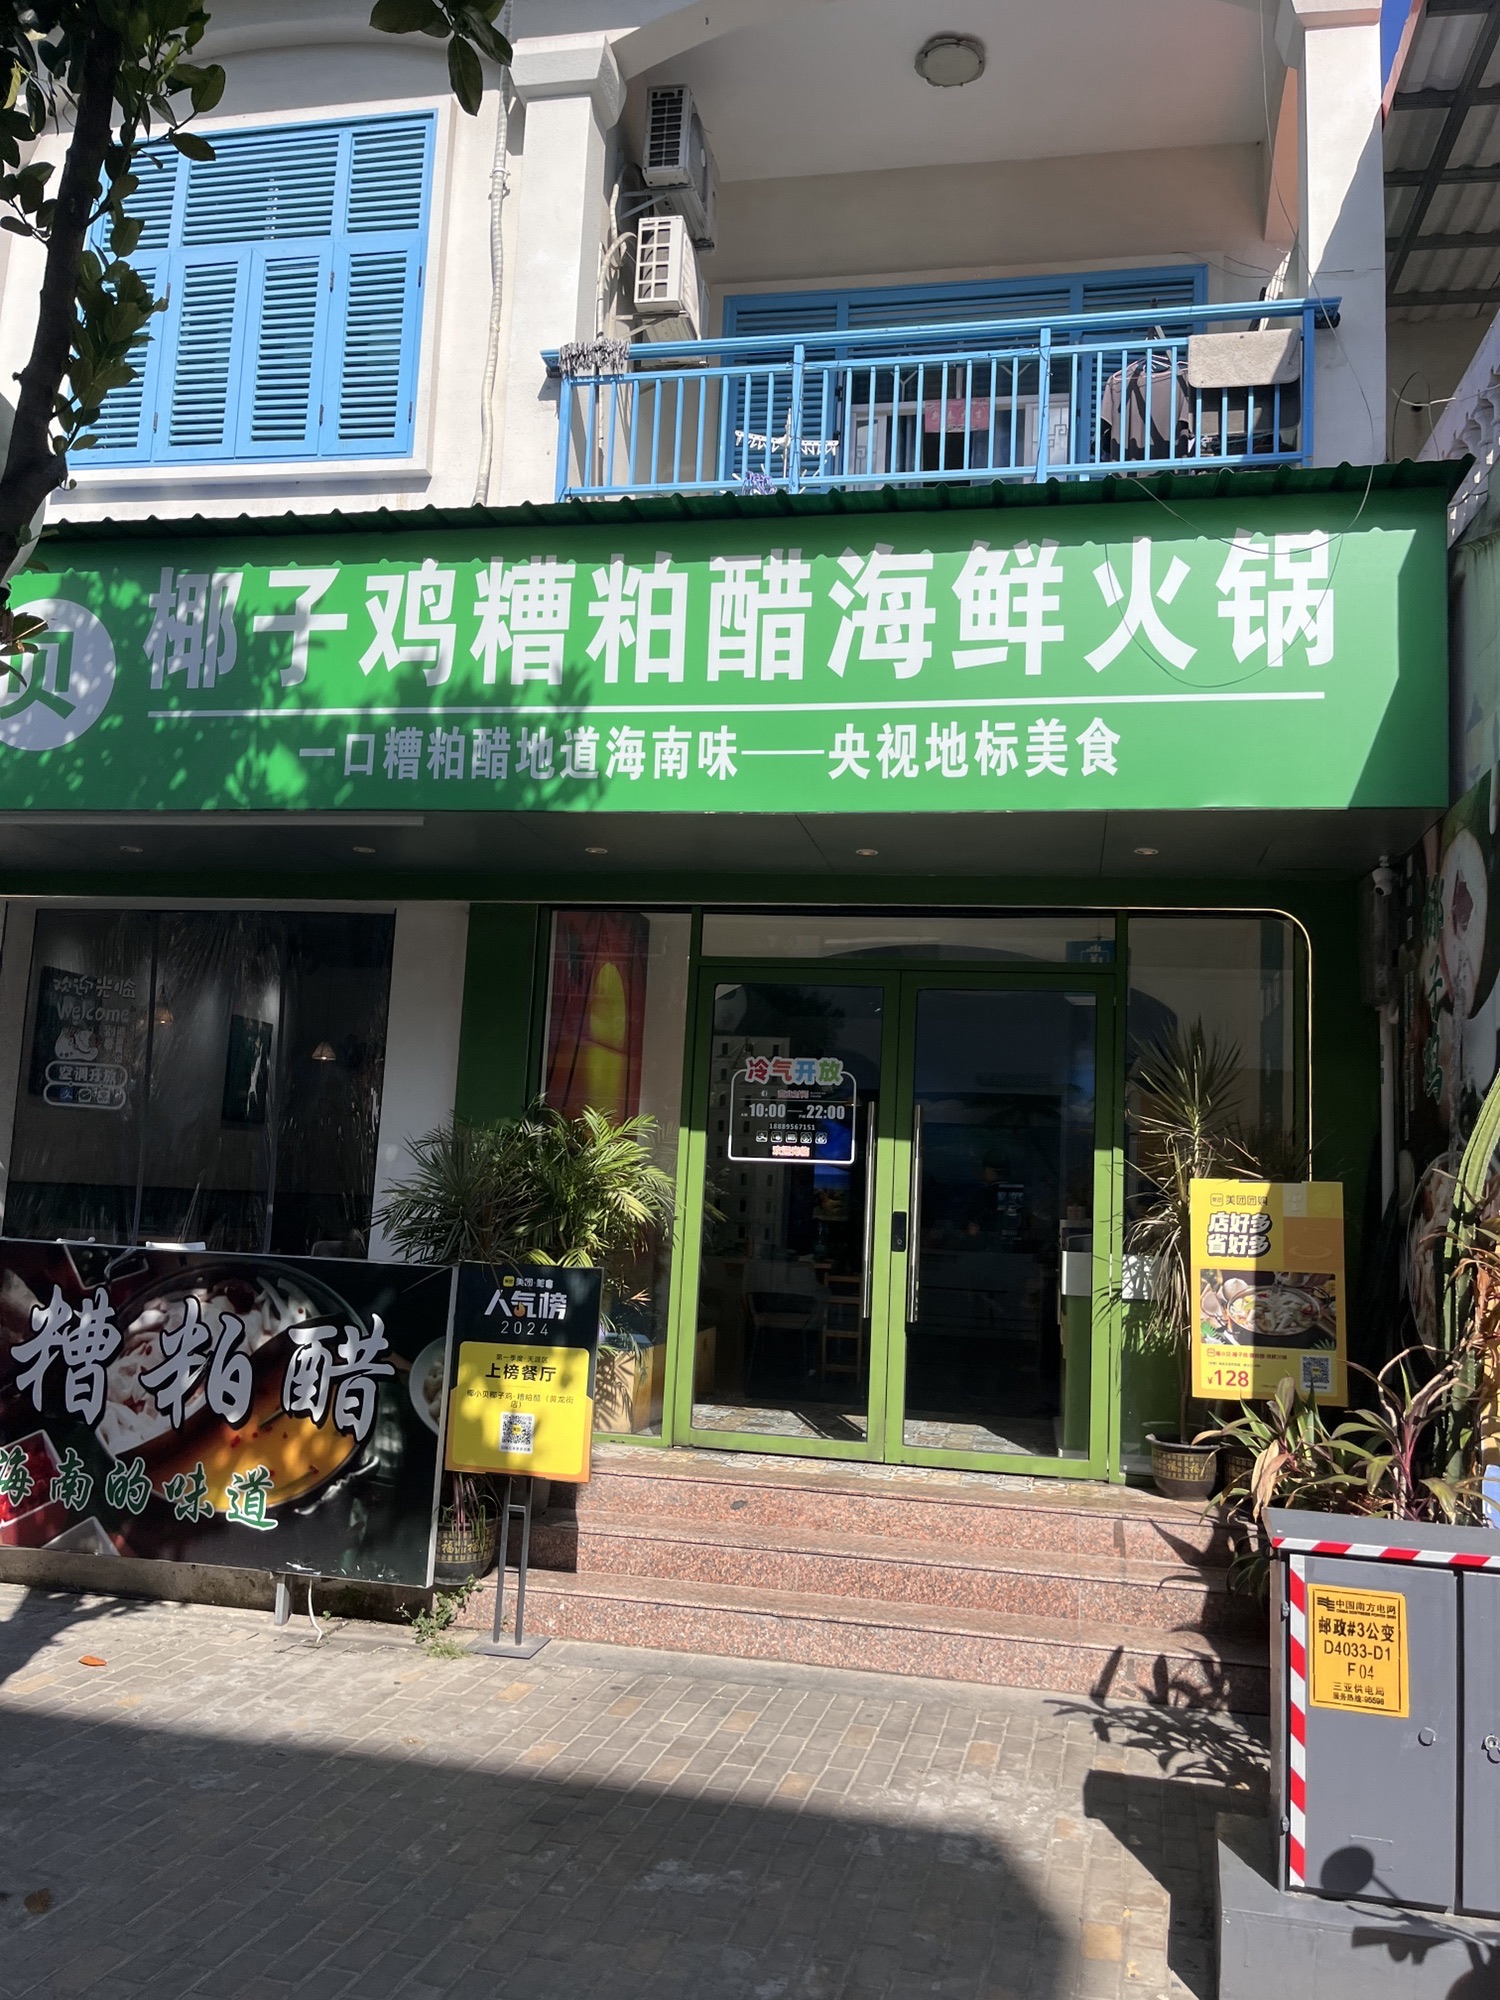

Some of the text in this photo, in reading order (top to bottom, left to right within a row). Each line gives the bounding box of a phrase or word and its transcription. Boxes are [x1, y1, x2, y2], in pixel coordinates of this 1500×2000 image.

[143, 528, 1335, 689] 椰子鸡糟粕醋海鲜火锅
[52, 975, 136, 999] 欢迎光临
[57, 1000, 130, 1023] Welcome
[746, 1058, 842, 1084] 冷气开放
[749, 1103, 786, 1118] 10:00
[806, 1104, 845, 1120] 22:00
[1207, 1211, 1272, 1234] 店好多
[1206, 1233, 1270, 1256] 省好多
[484, 1289, 568, 1320] 人气榜
[500, 1320, 549, 1336] 2024
[9, 1283, 399, 1442] 糟粕醋
[485, 1362, 557, 1382] 上榜餐厅
[0, 1446, 279, 1531] 海南的味道
[1335, 1599, 1396, 1615] 中国南方电网
[1318, 1616, 1395, 1643] 邮政#3公变
[1324, 1639, 1391, 1661] D4033-D1
[1333, 1681, 1385, 1697] 三亚供电局
